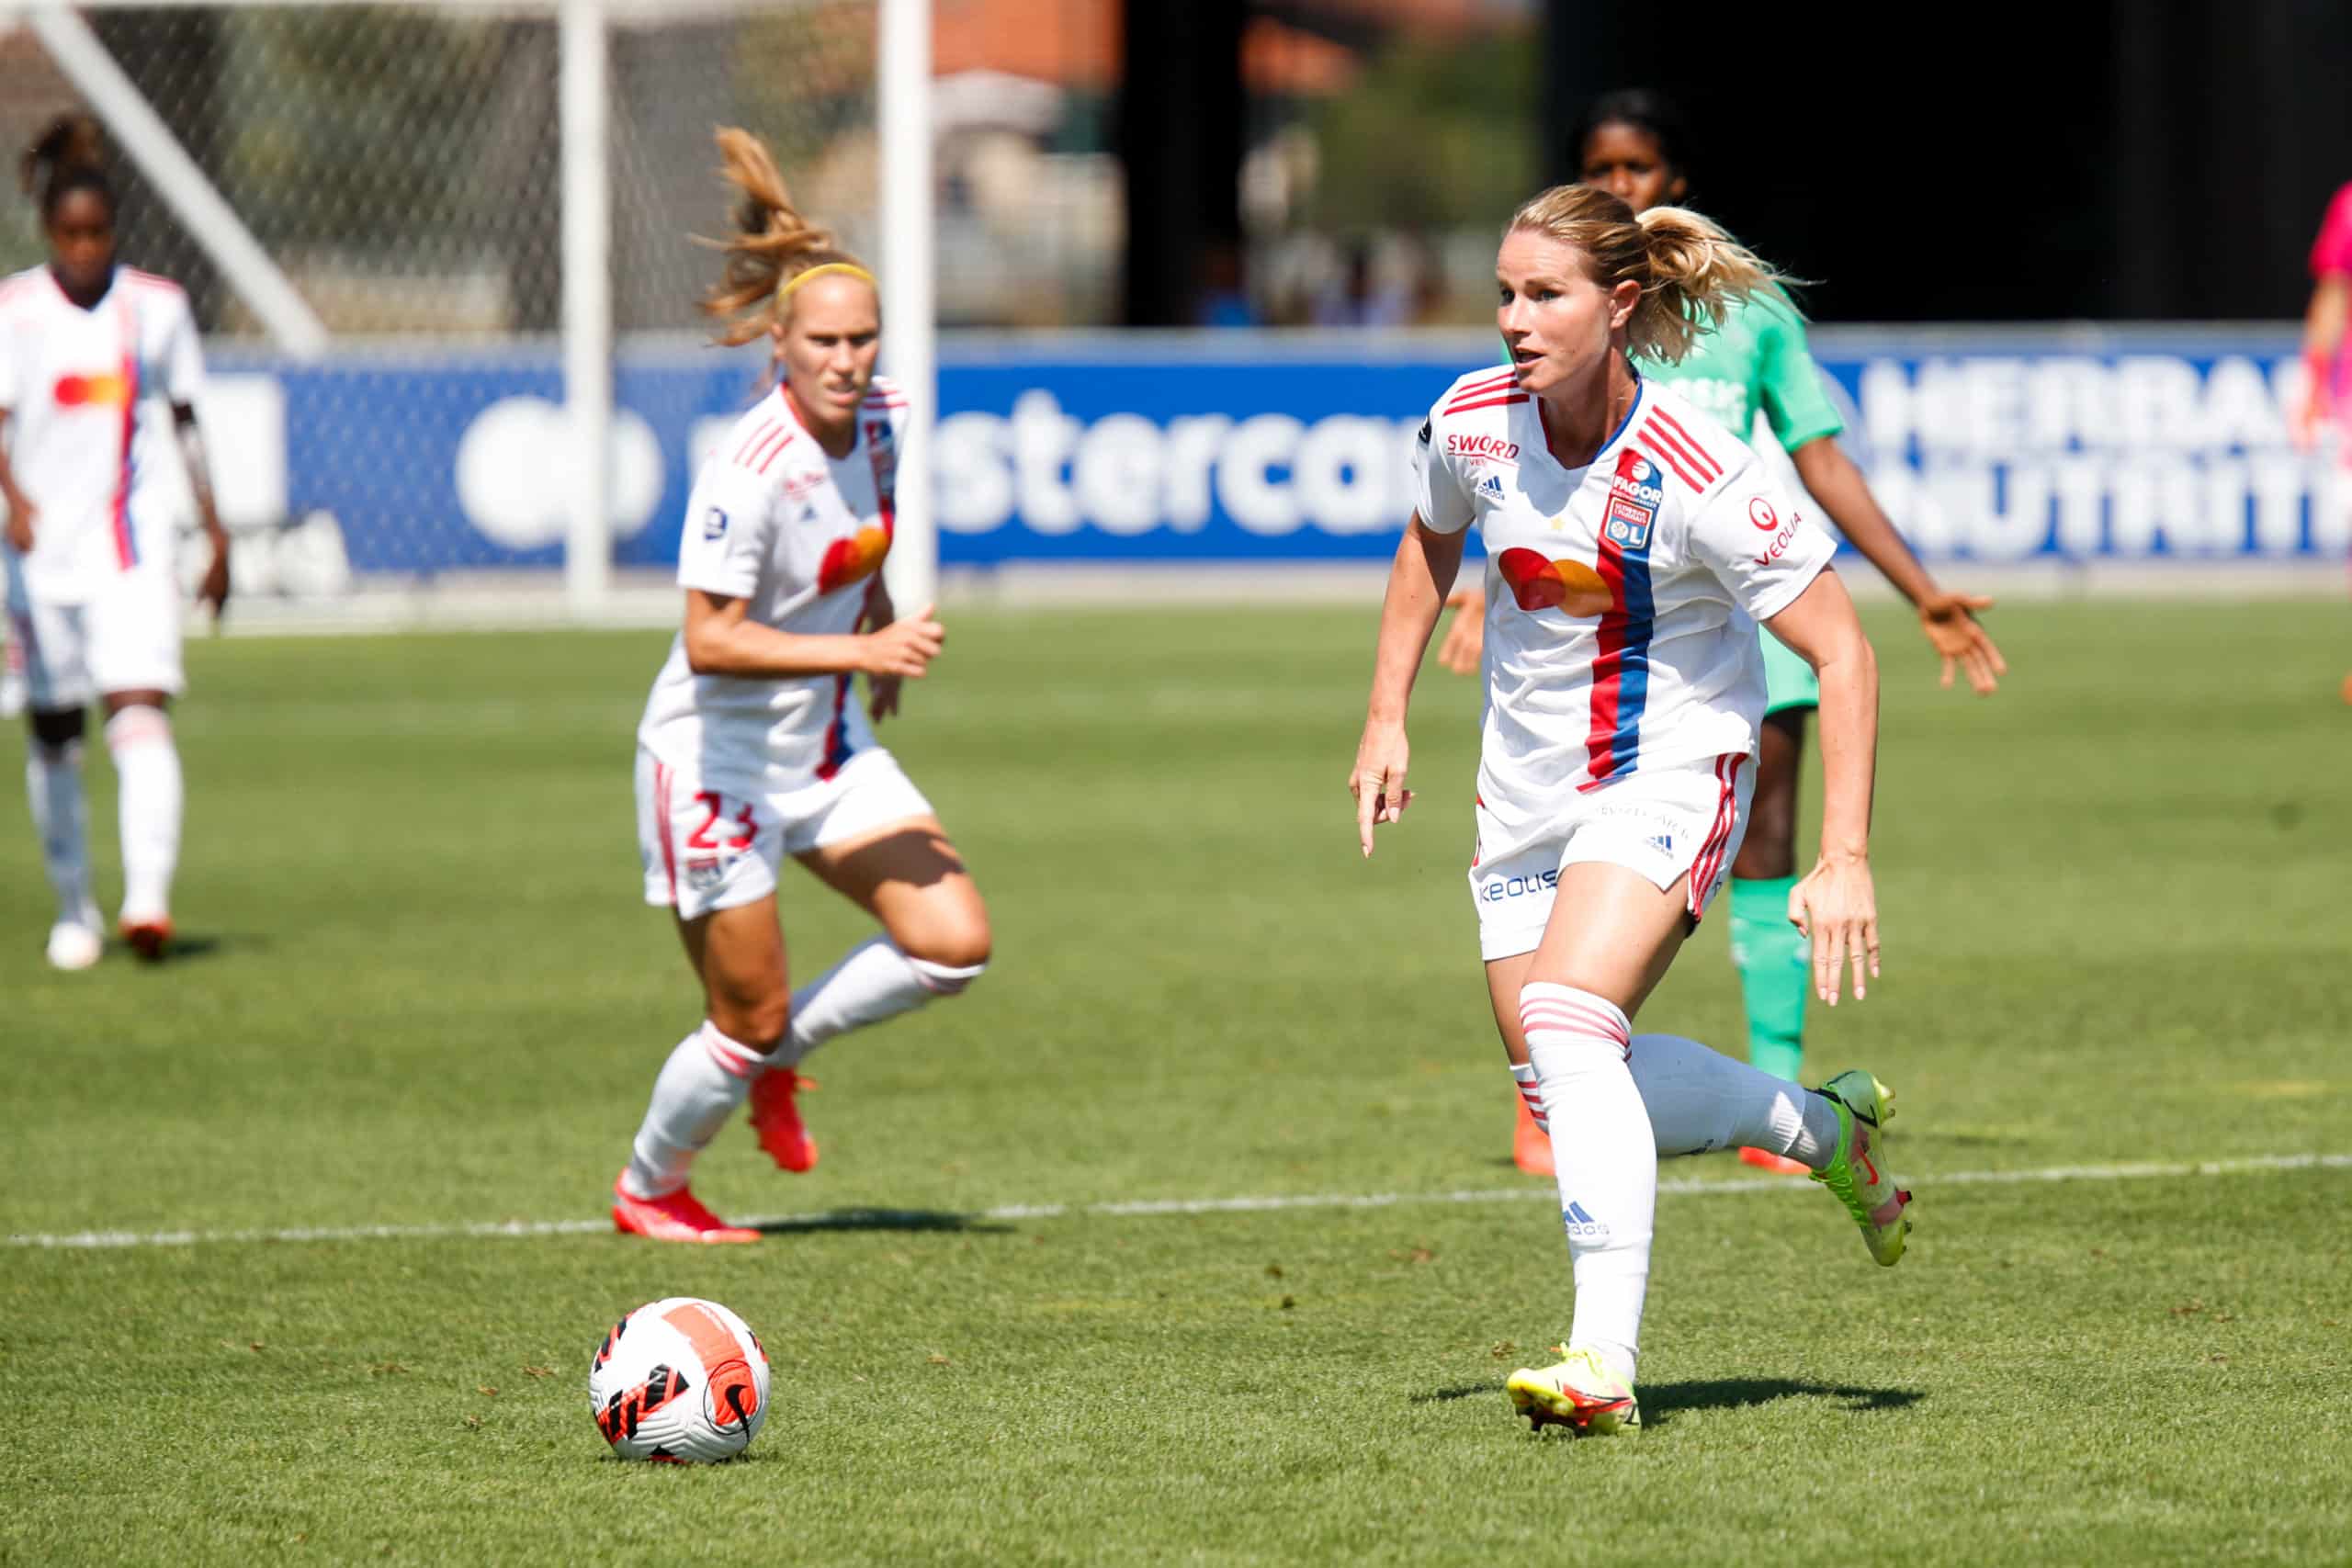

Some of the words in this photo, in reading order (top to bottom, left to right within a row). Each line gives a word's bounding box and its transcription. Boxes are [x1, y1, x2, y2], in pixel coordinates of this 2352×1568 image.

[1447, 434, 1521, 459] SWORD
[1613, 476, 1663, 504] FAGOR
[1753, 511, 1802, 566] VEOLIA
[685, 790, 760, 851] 23
